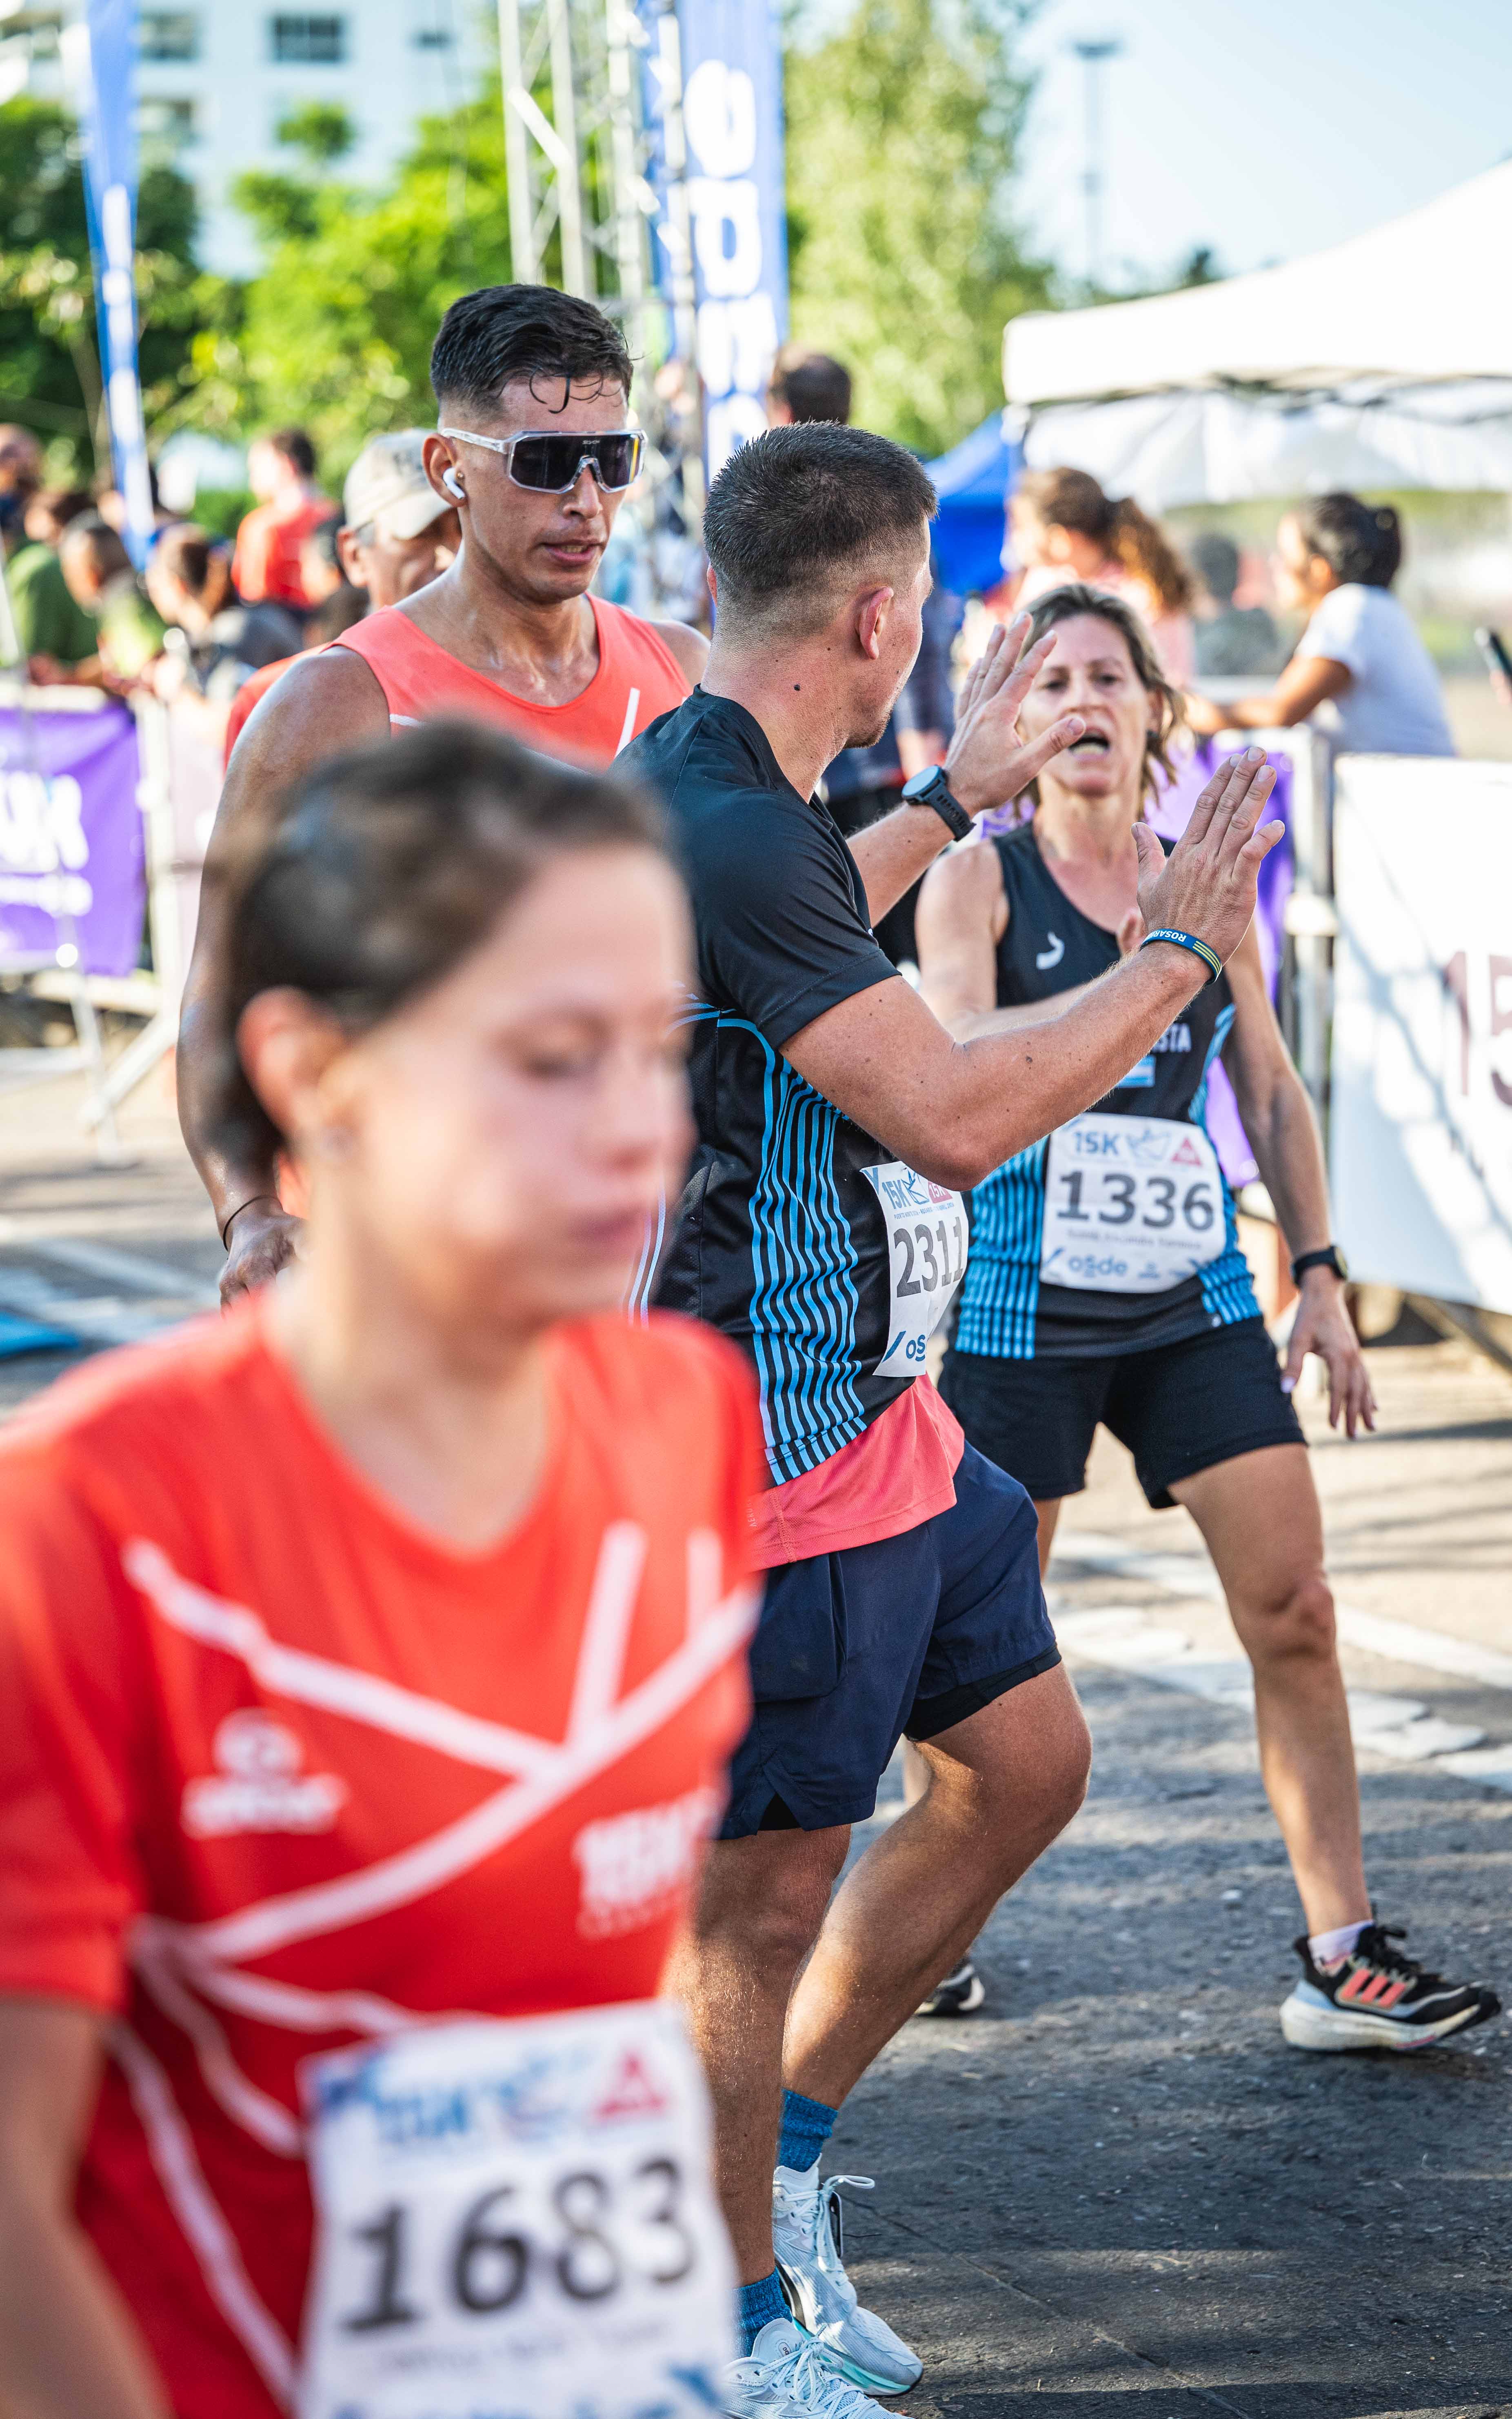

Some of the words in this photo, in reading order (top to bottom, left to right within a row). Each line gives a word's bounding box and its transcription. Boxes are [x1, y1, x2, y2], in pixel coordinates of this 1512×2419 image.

[1143, 930, 1187, 942] ROSARI
[1074, 1131, 1119, 1155] 15K
[882, 1180, 911, 1209] 15K
[1057, 1171, 1214, 1232] 1336
[894, 1217, 963, 1298] 2311
[342, 2157, 693, 2333] 1683
